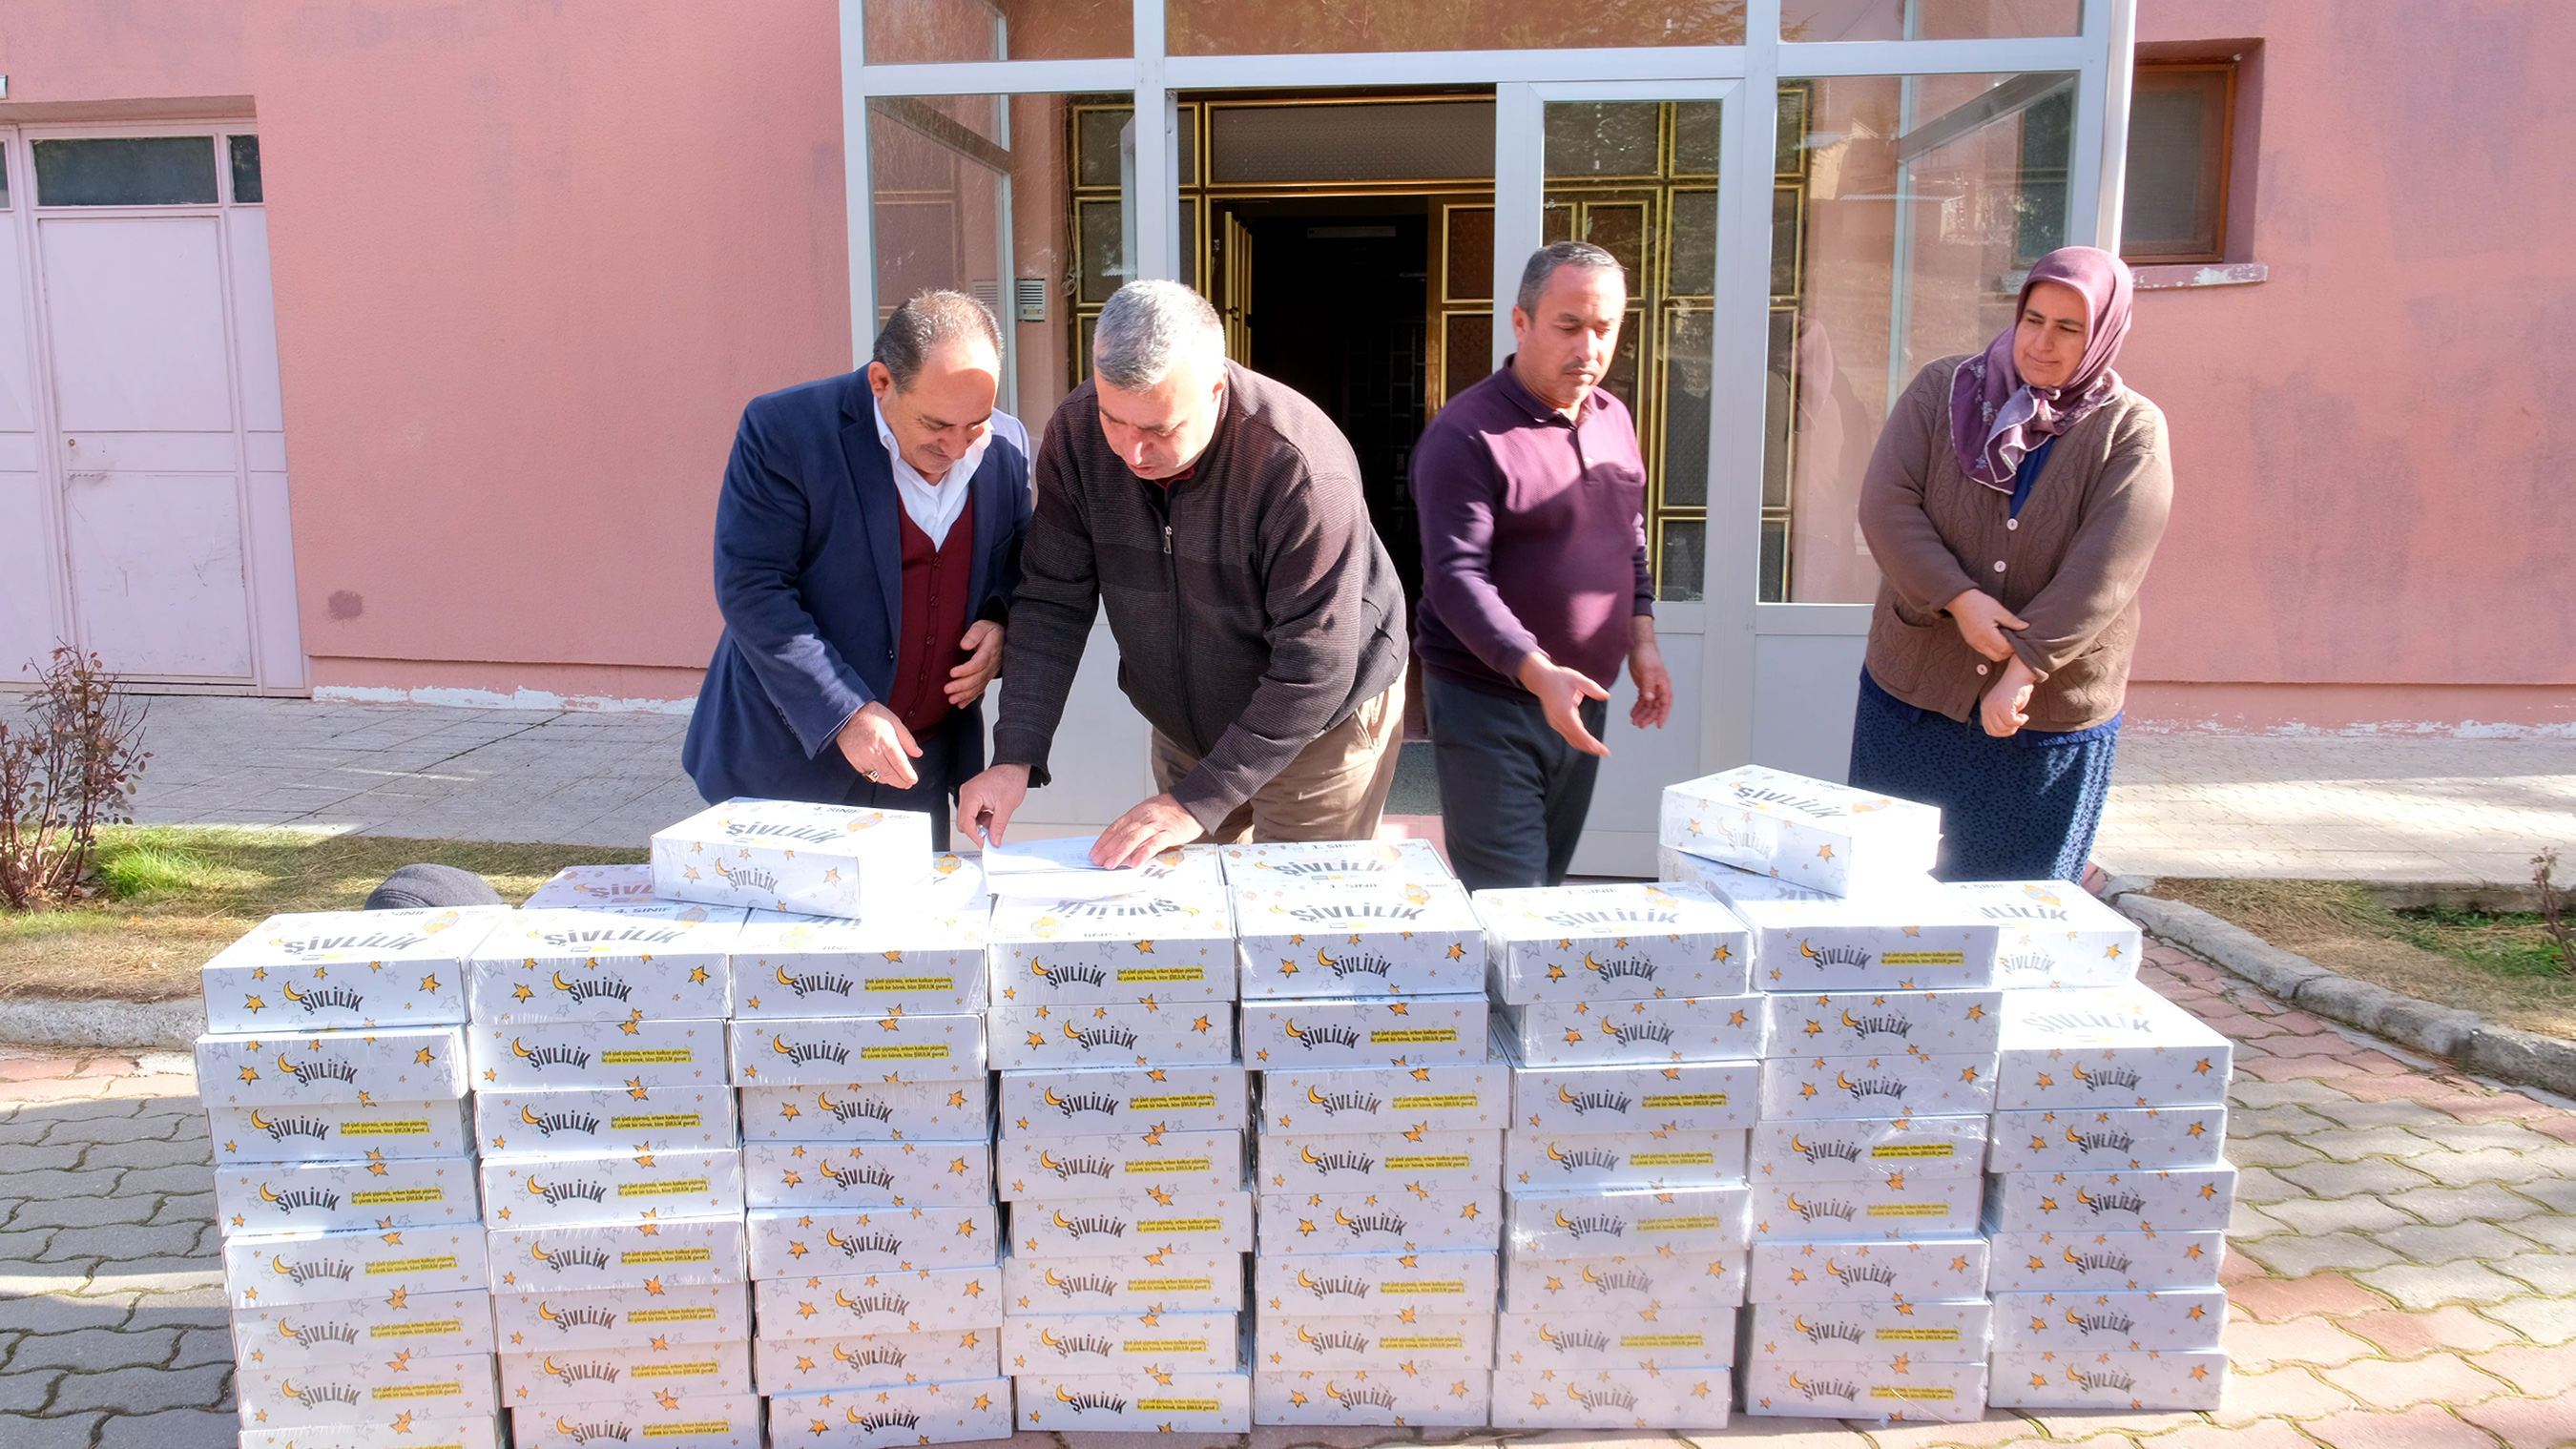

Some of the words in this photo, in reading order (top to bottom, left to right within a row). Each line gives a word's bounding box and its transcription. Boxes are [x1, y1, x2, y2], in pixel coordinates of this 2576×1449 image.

[1290, 902, 1426, 922] ŞİVLİLİK
[1331, 953, 1391, 981] ŞİVLİLİK
[1597, 957, 1658, 984] ŞİVLİLİK
[1815, 945, 1872, 970] ŞİVLİLİK
[792, 972, 854, 999] ŞİVLİLİK
[1046, 963, 1107, 989] ŞİVLİLİK
[300, 986, 364, 1015] ŞİVLİLİK
[569, 977, 632, 1004] ŞİVLİLİK
[1078, 1025, 1138, 1052] ŞİVLİLİK
[1300, 1025, 1360, 1051] ŞİVLİLİK
[1614, 1021, 1674, 1047] ŞİVLİLİK
[1855, 1014, 1913, 1039] ŞİVLİLİK
[528, 1044, 591, 1071] ŞİVLİLİK
[788, 1040, 850, 1067] ŞİVLİLİK
[294, 1059, 358, 1086] ŞİVLİLİK
[1851, 1076, 1907, 1101] ŞİVLİLİK
[834, 1099, 893, 1124] ŞİVLİLİK
[1059, 1091, 1119, 1119] ŞİVLİLİK
[1323, 1090, 1382, 1117] ŞİVLİLİK
[1572, 1089, 1632, 1116] ŞİVLİLİK
[267, 1116, 330, 1142] ŞİVLİLİK
[537, 1110, 600, 1137] ŞİVLİLİK
[1054, 1155, 1115, 1182] ŞİVLİLİK
[1316, 1149, 1374, 1176] ŞİVLİLİK
[1563, 1148, 1620, 1173] ŞİVLİLİK
[836, 1166, 895, 1190] ŞİVLİLİK
[276, 1187, 341, 1215] ŞİVLİLİK
[544, 1179, 607, 1208] ŞİVLİLİK
[1068, 1214, 1126, 1240] ŞİVLİLİK
[1349, 1212, 1407, 1238] ŞİVLİLİK
[1570, 1213, 1627, 1239] ŞİVLİLİK
[841, 1232, 903, 1258] ŞİVLİLİK
[289, 1258, 354, 1287] ŞİVLİLİK
[547, 1246, 610, 1273] ŞİVLİLİK
[1059, 1273, 1118, 1298] ŞİVLİLİK
[1312, 1275, 1370, 1301] ŞİVLİLİK
[851, 1294, 910, 1319] ŞİVLİLİK
[554, 1306, 616, 1334] ŞİVLİLİK
[294, 1321, 359, 1349] ŞİVLİLİK
[1056, 1334, 1112, 1358] ŞİVLİLİK
[1311, 1331, 1370, 1356] ŞİVLİLİK
[848, 1346, 906, 1372] ŞİVLİLİK
[559, 1361, 619, 1387] ŞİVLİLİK
[300, 1383, 361, 1410] ŞİVLİLİK
[1070, 1391, 1127, 1414] ŞİVLİLİK
[1340, 1388, 1398, 1411] ŞİVLİLİK
[572, 1421, 632, 1446] ŞİVLİLİK
[861, 1410, 920, 1434] ŞİVLİLİK
